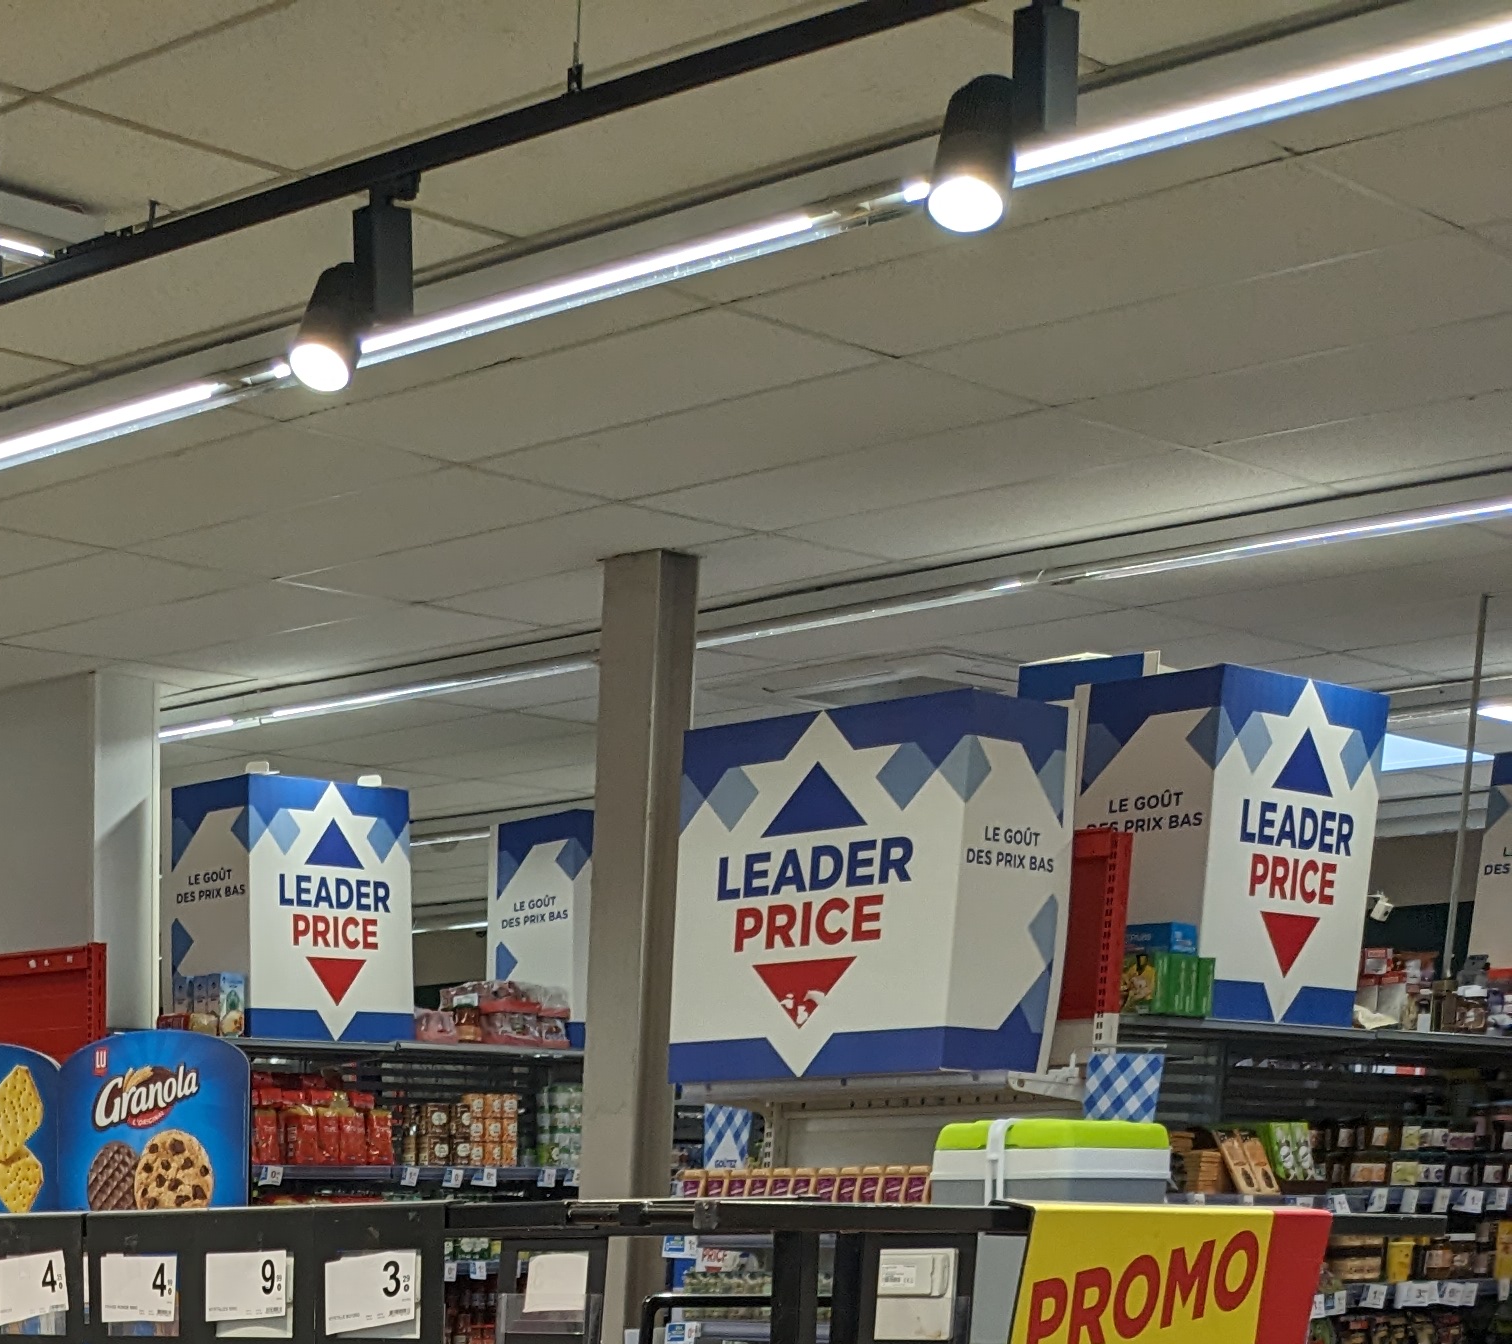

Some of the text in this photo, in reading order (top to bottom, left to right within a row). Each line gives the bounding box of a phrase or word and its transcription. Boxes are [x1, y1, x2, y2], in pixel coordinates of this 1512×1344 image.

[1109, 789, 1183, 814] LE GOÛT
[984, 825, 1040, 847] LE GOÛT
[1125, 812, 1203, 833] PRIX BAS
[1240, 799, 1354, 856] LEADER
[189, 867, 232, 886] LE GOÛT
[717, 837, 914, 901] LEADER
[966, 849, 1054, 873] DES PRIX BAS
[1484, 863, 1511, 876] DES
[176, 883, 246, 904] DES PRIX BAS
[279, 873, 391, 914] LEADER
[1249, 853, 1337, 905] PRICE
[501, 908, 569, 930] DES PRIX BAS
[514, 895, 557, 912] LE GOÛT
[292, 914, 379, 950] PRICE
[734, 894, 884, 952] PRICE
[95, 1049, 107, 1069] LU
[95, 1064, 199, 1128] Granola
[42, 1260, 57, 1293] 4
[152, 1263, 167, 1297] 4
[261, 1259, 275, 1295] 9
[382, 1260, 401, 1297] 3
